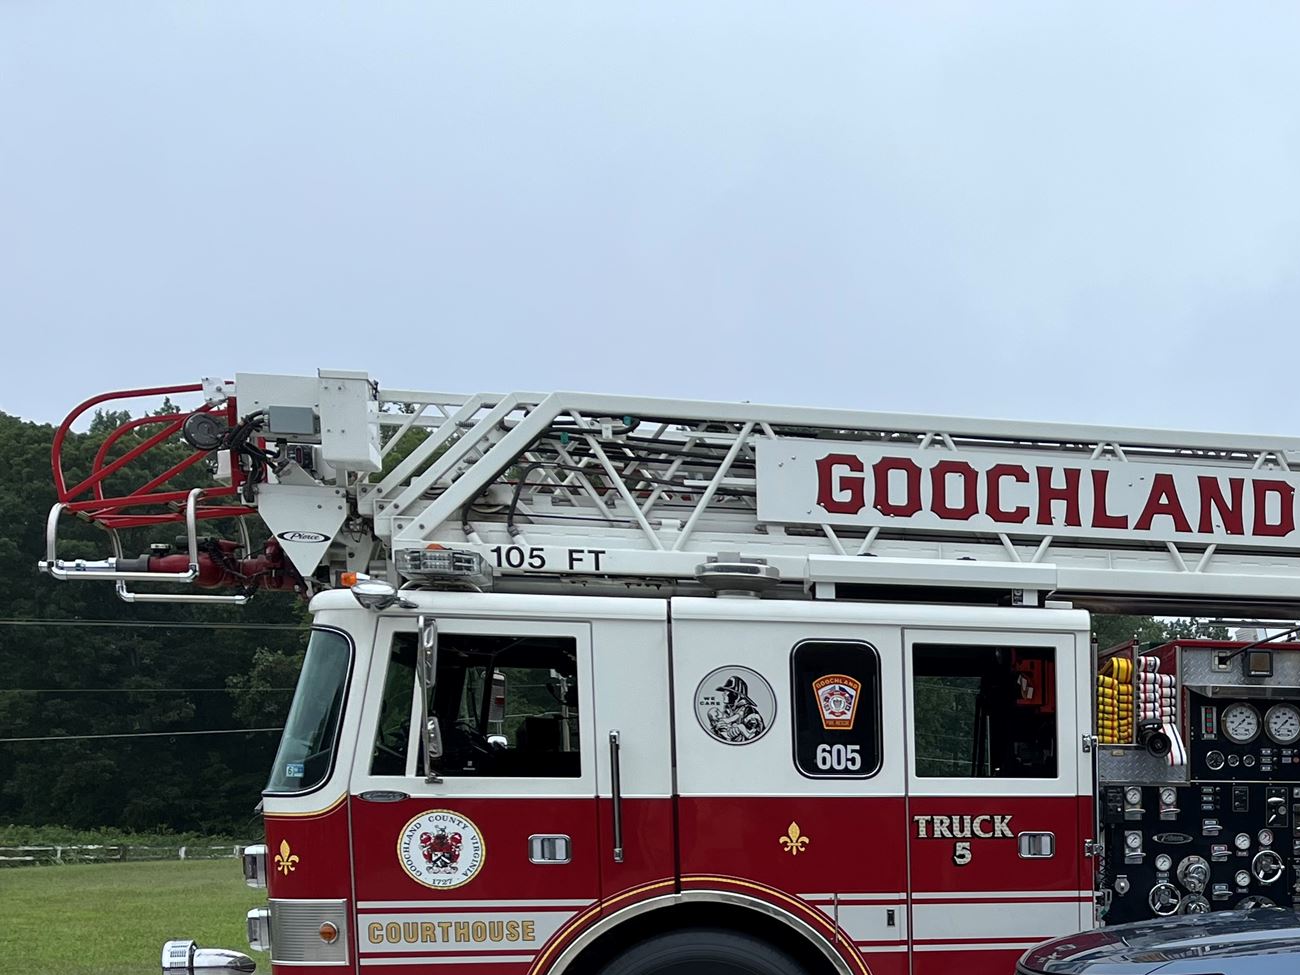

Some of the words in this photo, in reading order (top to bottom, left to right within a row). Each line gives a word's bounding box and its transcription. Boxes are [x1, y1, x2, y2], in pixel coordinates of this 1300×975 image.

[815, 452, 1296, 538] GOOCHLAND
[489, 545, 547, 570] 105
[567, 548, 606, 572] FT
[816, 743, 862, 771] 605
[913, 814, 1015, 839] TRUCK
[402, 822, 423, 877] GOOCHLAND
[428, 814, 469, 831] COUNTY
[461, 835, 481, 878] VIRGINIA
[953, 841, 973, 866] 5
[431, 878, 453, 886] 1727
[367, 920, 536, 945] COURTHOUSE
